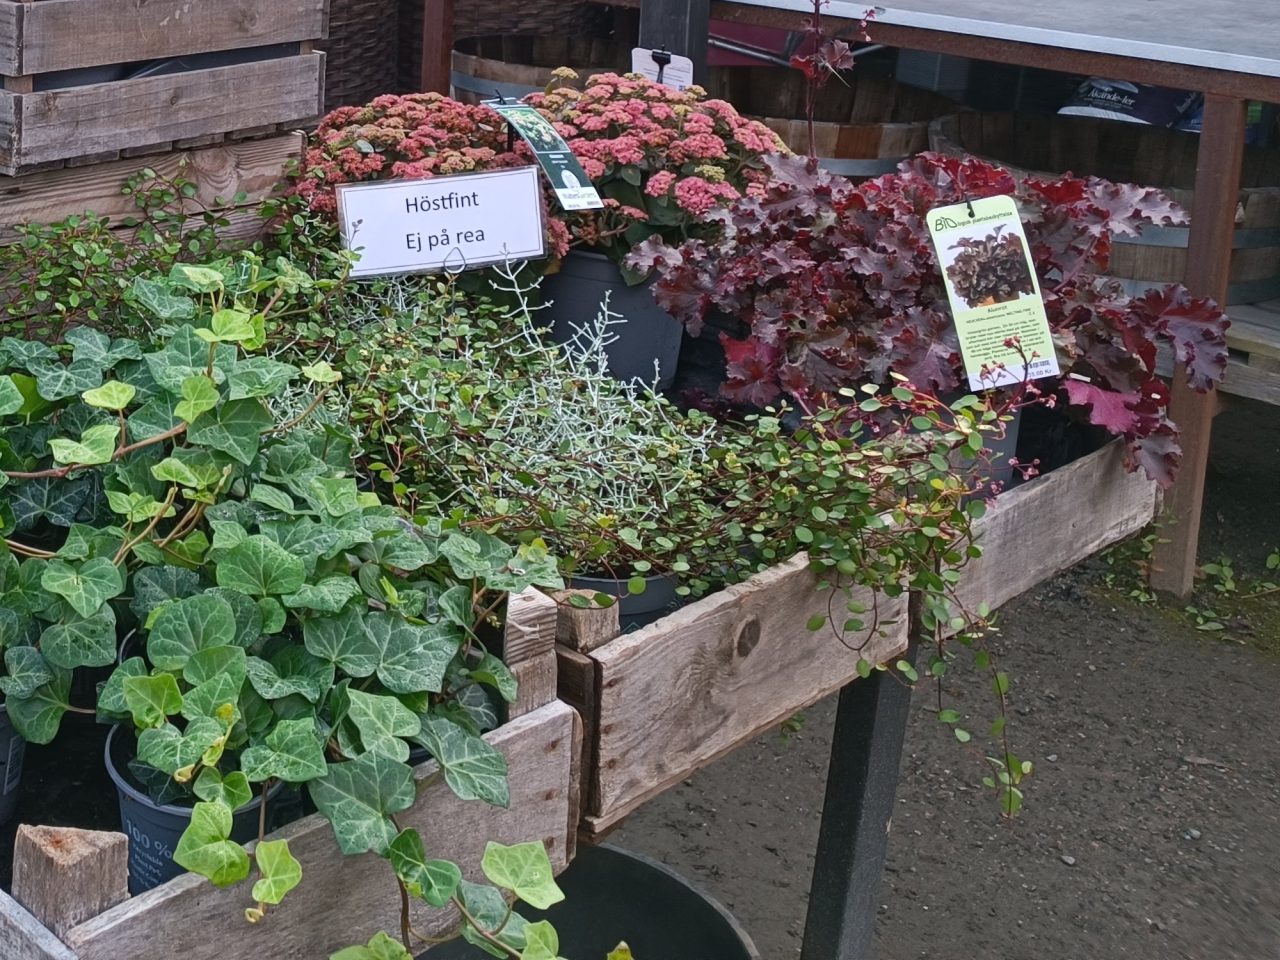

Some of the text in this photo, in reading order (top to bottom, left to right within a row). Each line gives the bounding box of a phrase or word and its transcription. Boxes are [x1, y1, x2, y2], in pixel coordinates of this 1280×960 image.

[405, 191, 480, 214] Höstfint
[405, 228, 485, 252] Ej på rea
[126, 819, 173, 858] 100 %
